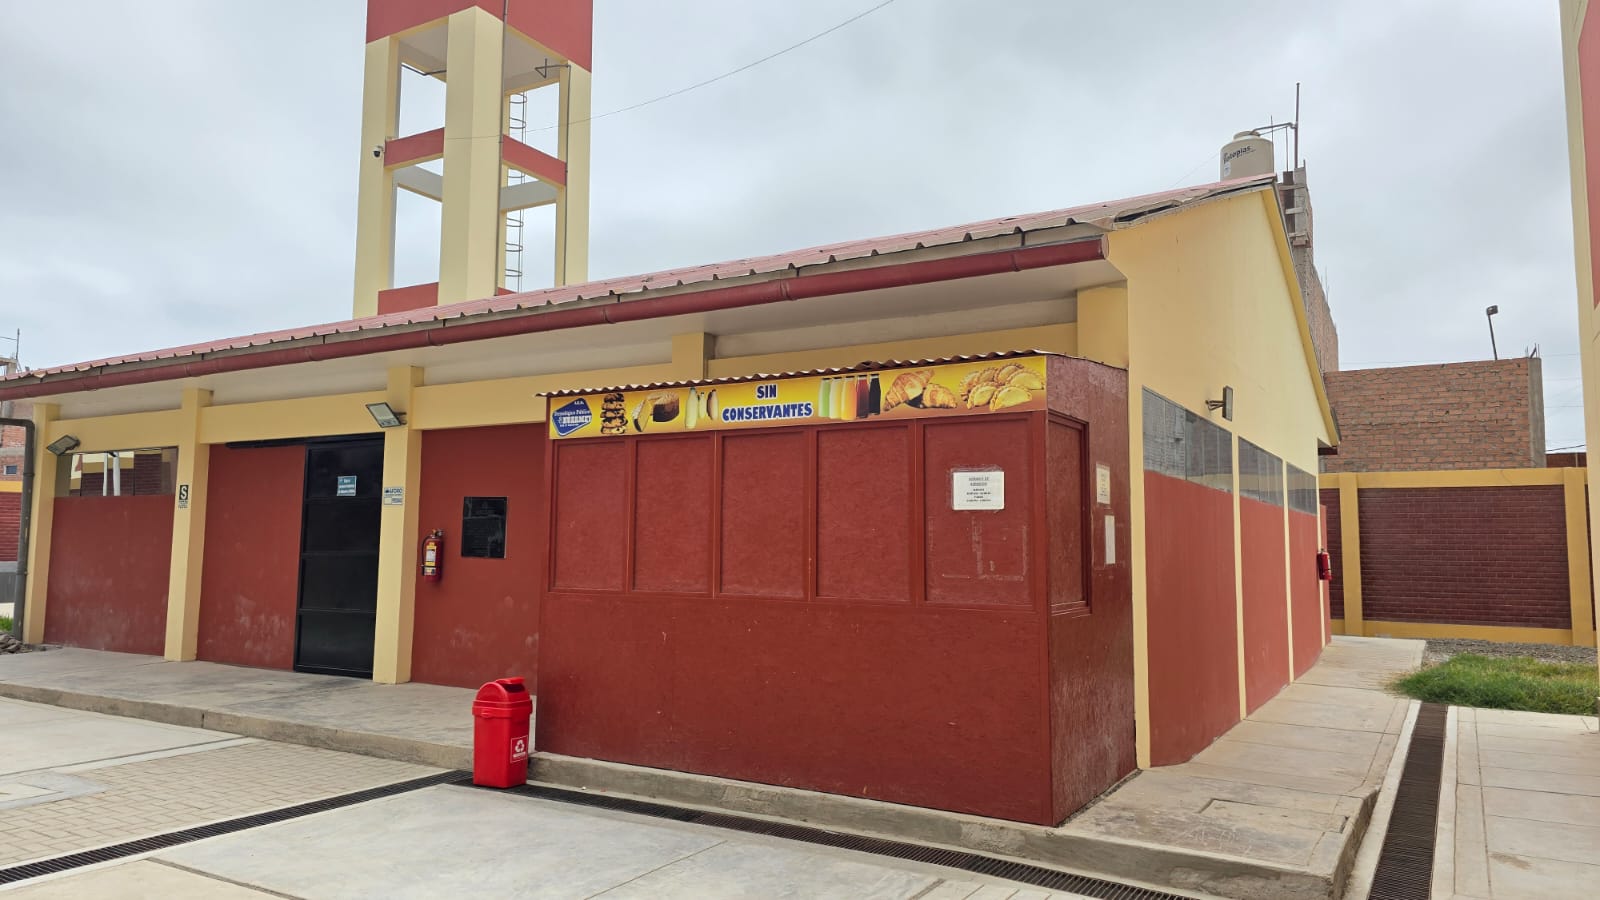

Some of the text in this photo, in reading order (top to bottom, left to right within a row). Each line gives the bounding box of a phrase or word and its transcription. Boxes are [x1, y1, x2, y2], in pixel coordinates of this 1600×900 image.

[757, 384, 777, 399] SIN
[722, 403, 813, 421] CONSERVANTES
[181, 485, 188, 500] S
